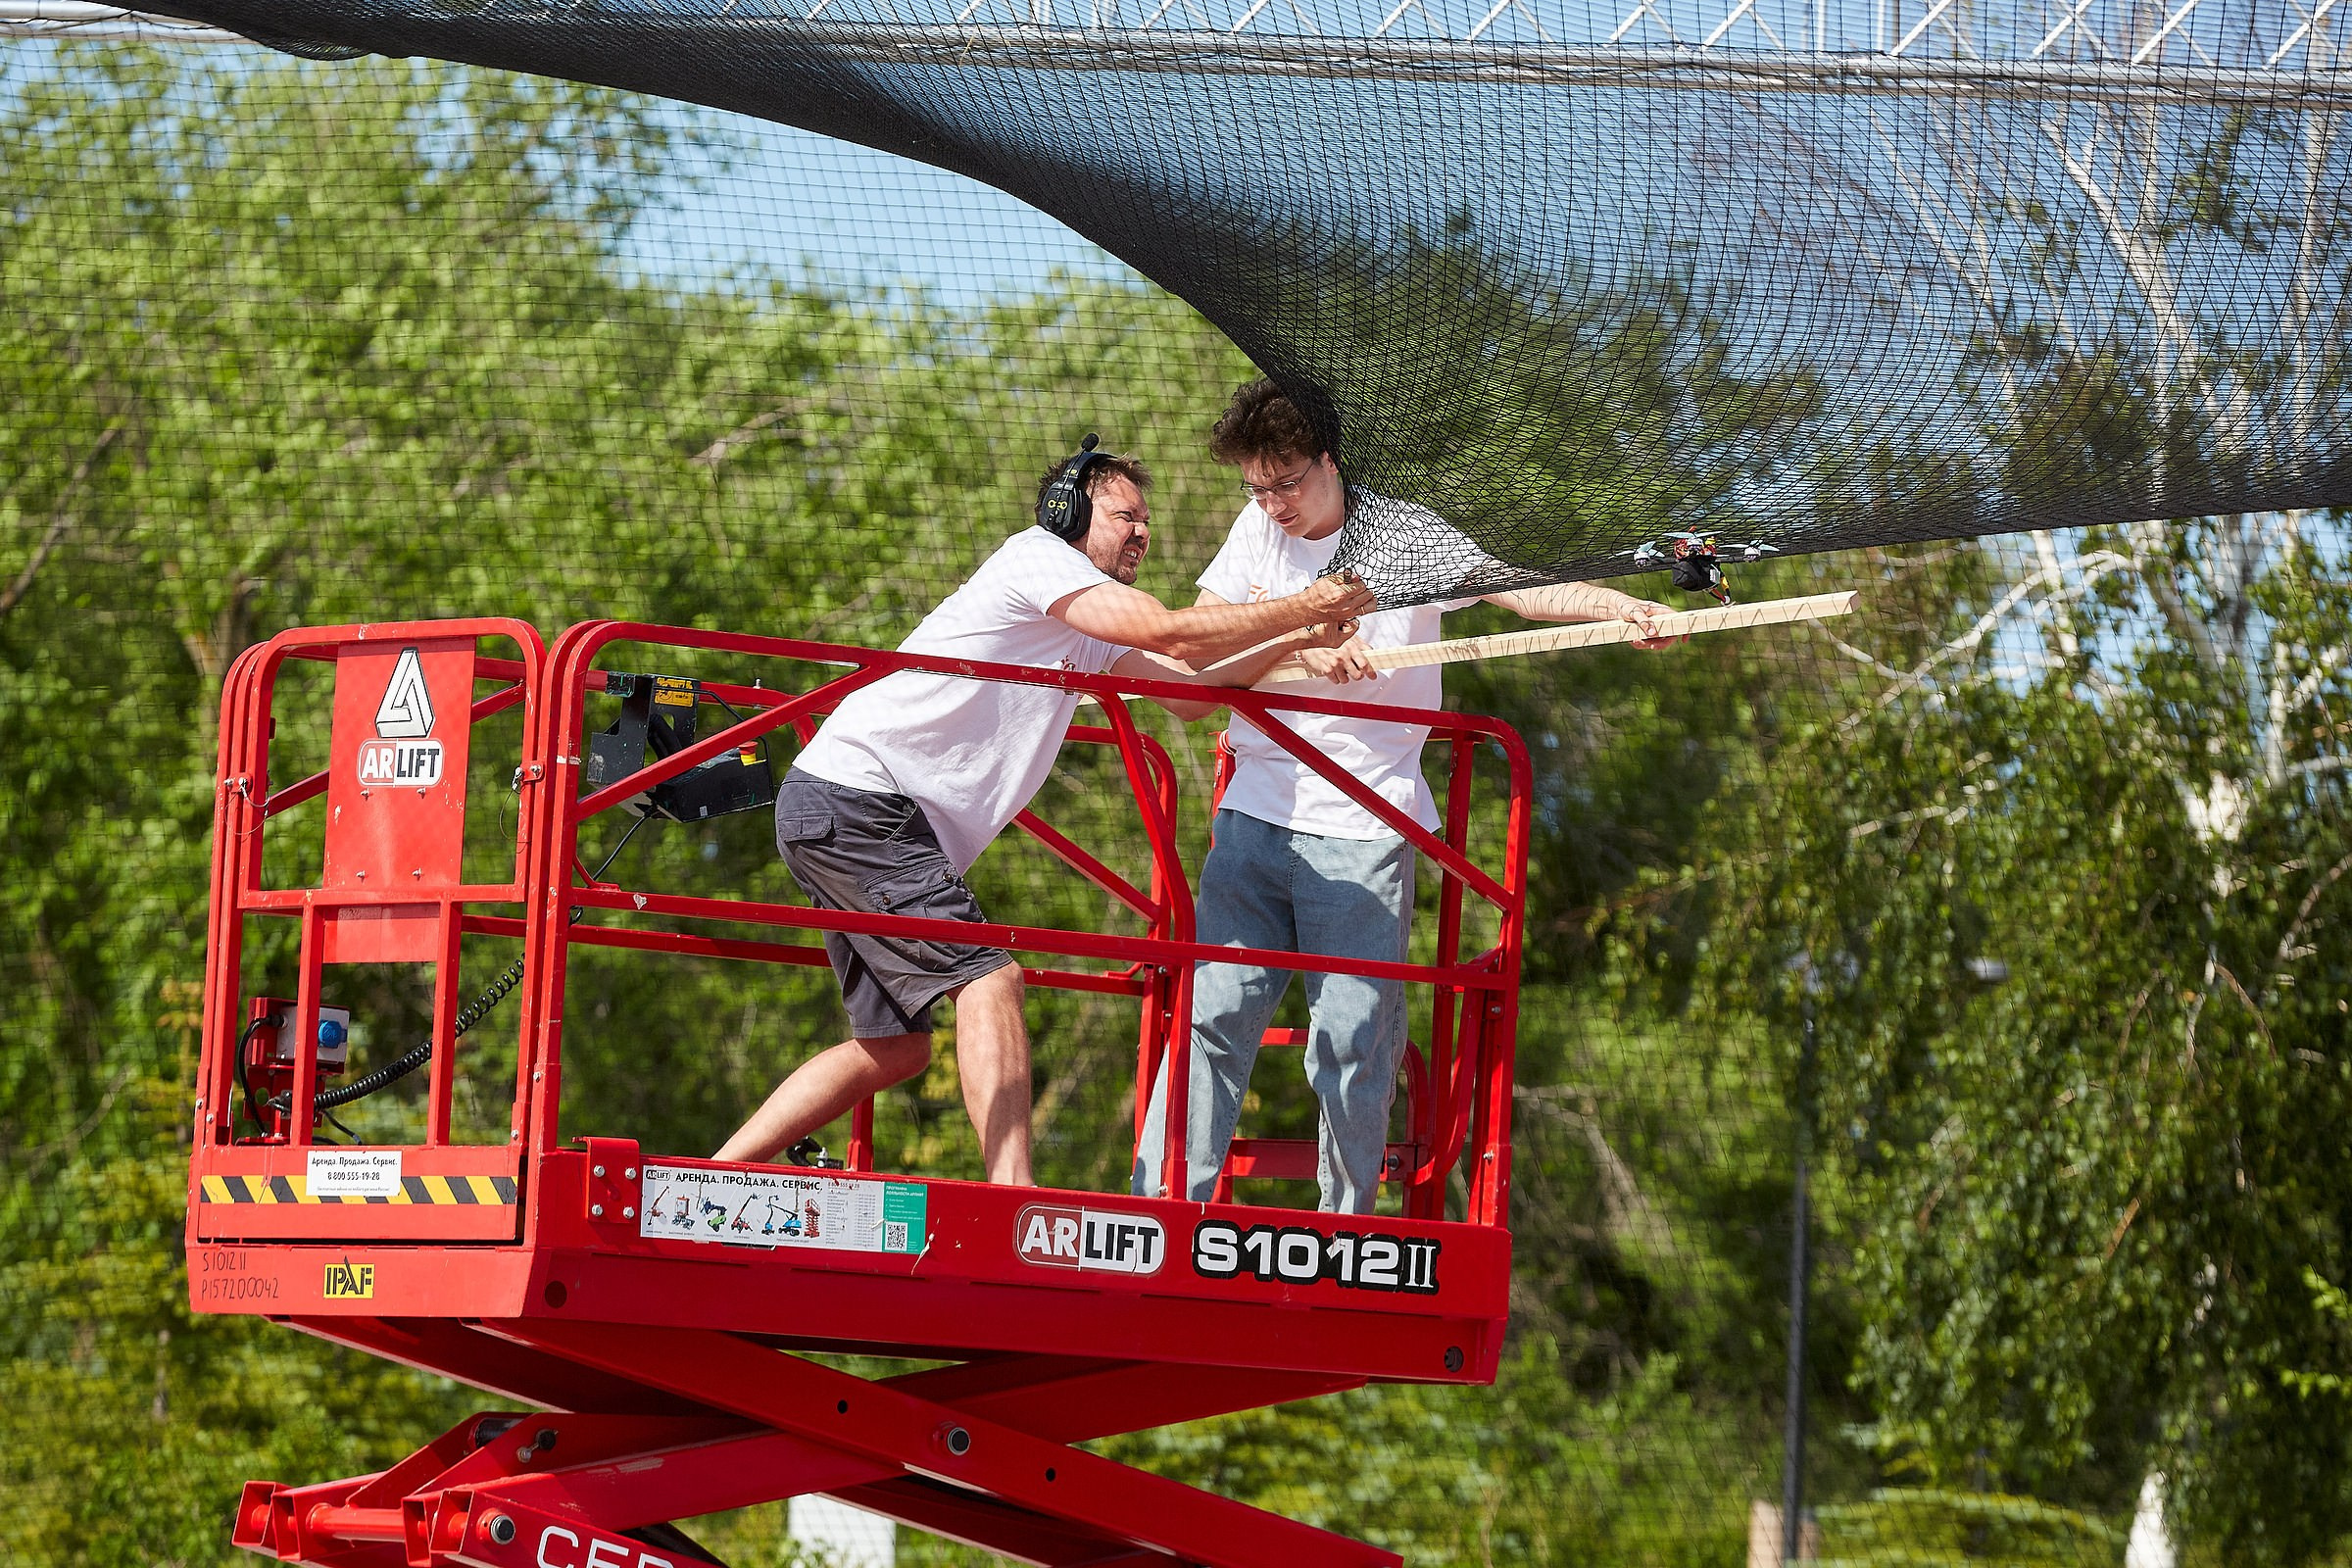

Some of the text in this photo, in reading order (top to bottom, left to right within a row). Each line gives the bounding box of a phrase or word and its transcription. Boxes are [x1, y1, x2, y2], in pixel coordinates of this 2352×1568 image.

[361, 748, 440, 779] ARLIFT
[312, 1156, 398, 1167] Аренда. Продажа. Сервис.
[347, 1171, 380, 1181] 555-19-28
[647, 1170, 669, 1179] ARLIFT
[675, 1173, 719, 1185] АРЕНДА.
[722, 1176, 779, 1188] ПРОДАЖА.
[1020, 1214, 1159, 1265] ARLIFT
[324, 1256, 373, 1297] IPAF
